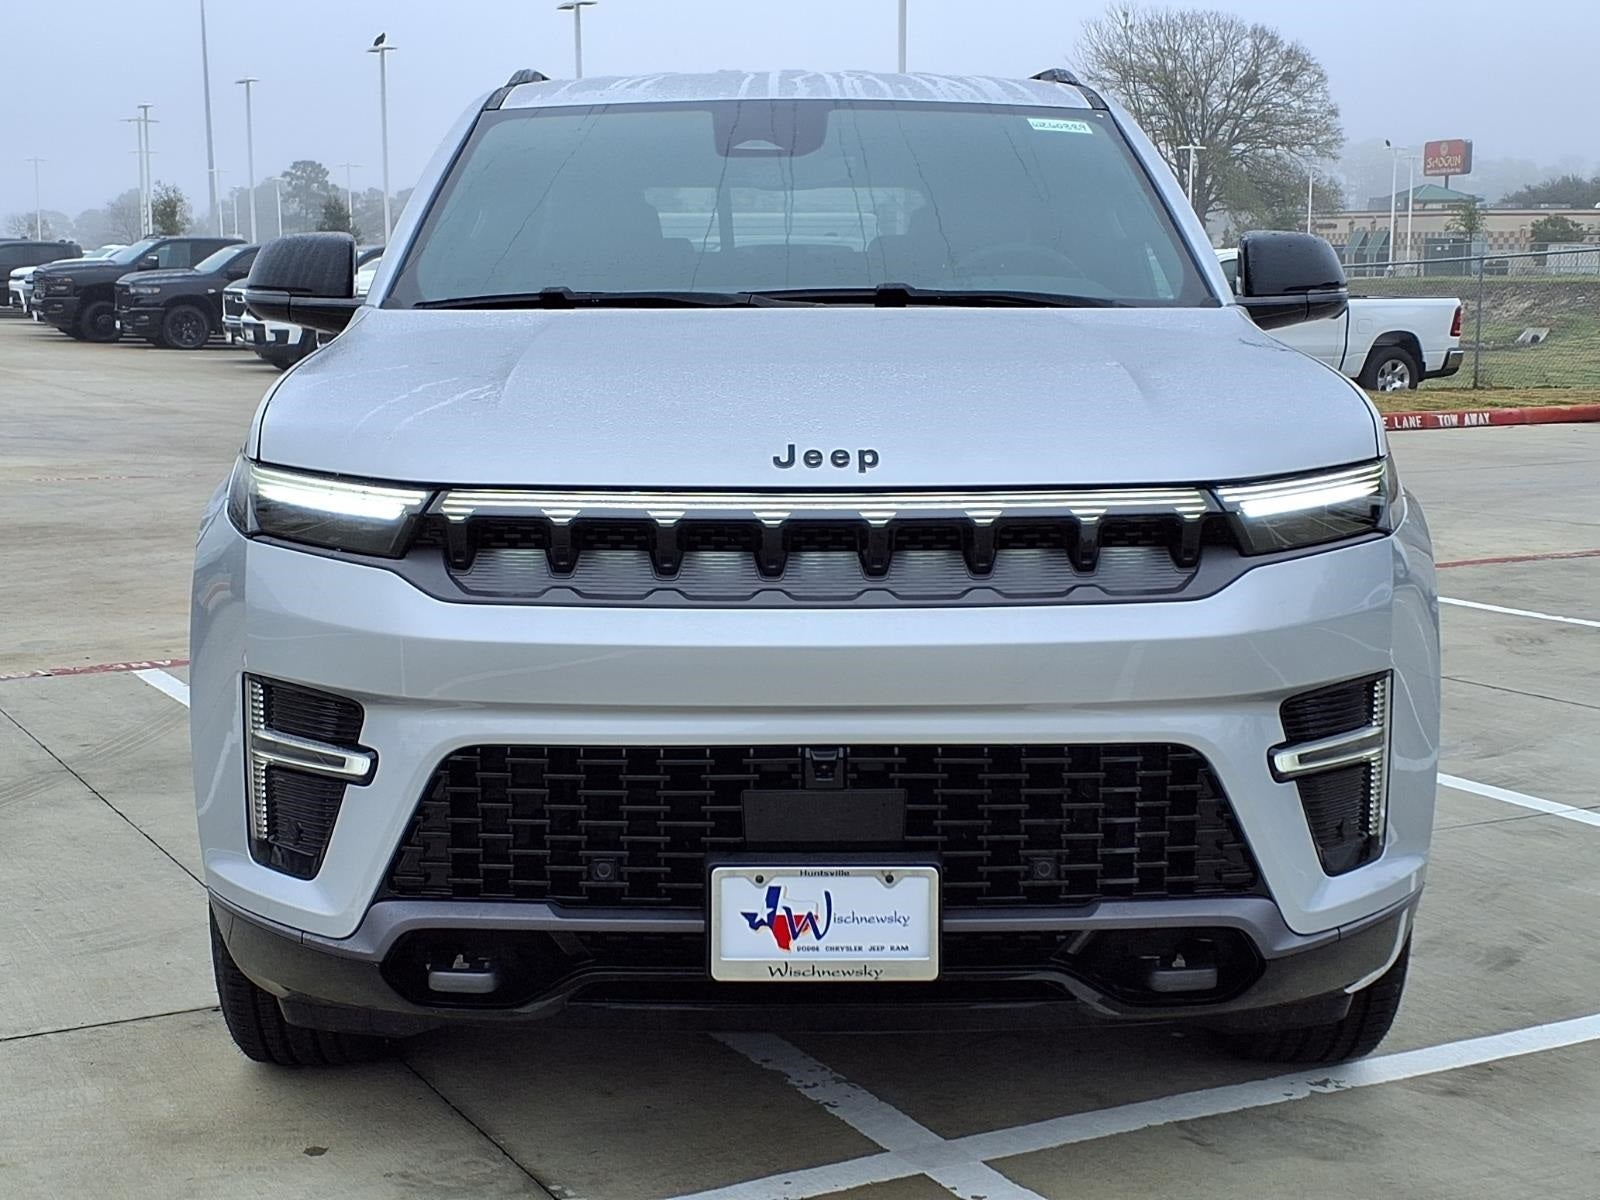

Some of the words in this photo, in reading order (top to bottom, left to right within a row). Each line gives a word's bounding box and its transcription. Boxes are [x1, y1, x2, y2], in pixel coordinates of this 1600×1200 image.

[1394, 415, 1422, 429] LANE
[1436, 414, 1459, 427] TOW
[1464, 412, 1490, 426] AWAY
[772, 443, 880, 473] Jeep
[799, 869, 850, 877] Huntsville
[782, 890, 911, 941] Wischnewsky
[796, 945, 820, 953] DODGE
[825, 944, 863, 952] CHRYSLER
[868, 944, 886, 952] JEEP
[890, 944, 910, 952] RAM
[767, 961, 883, 979] Wischnewsky
